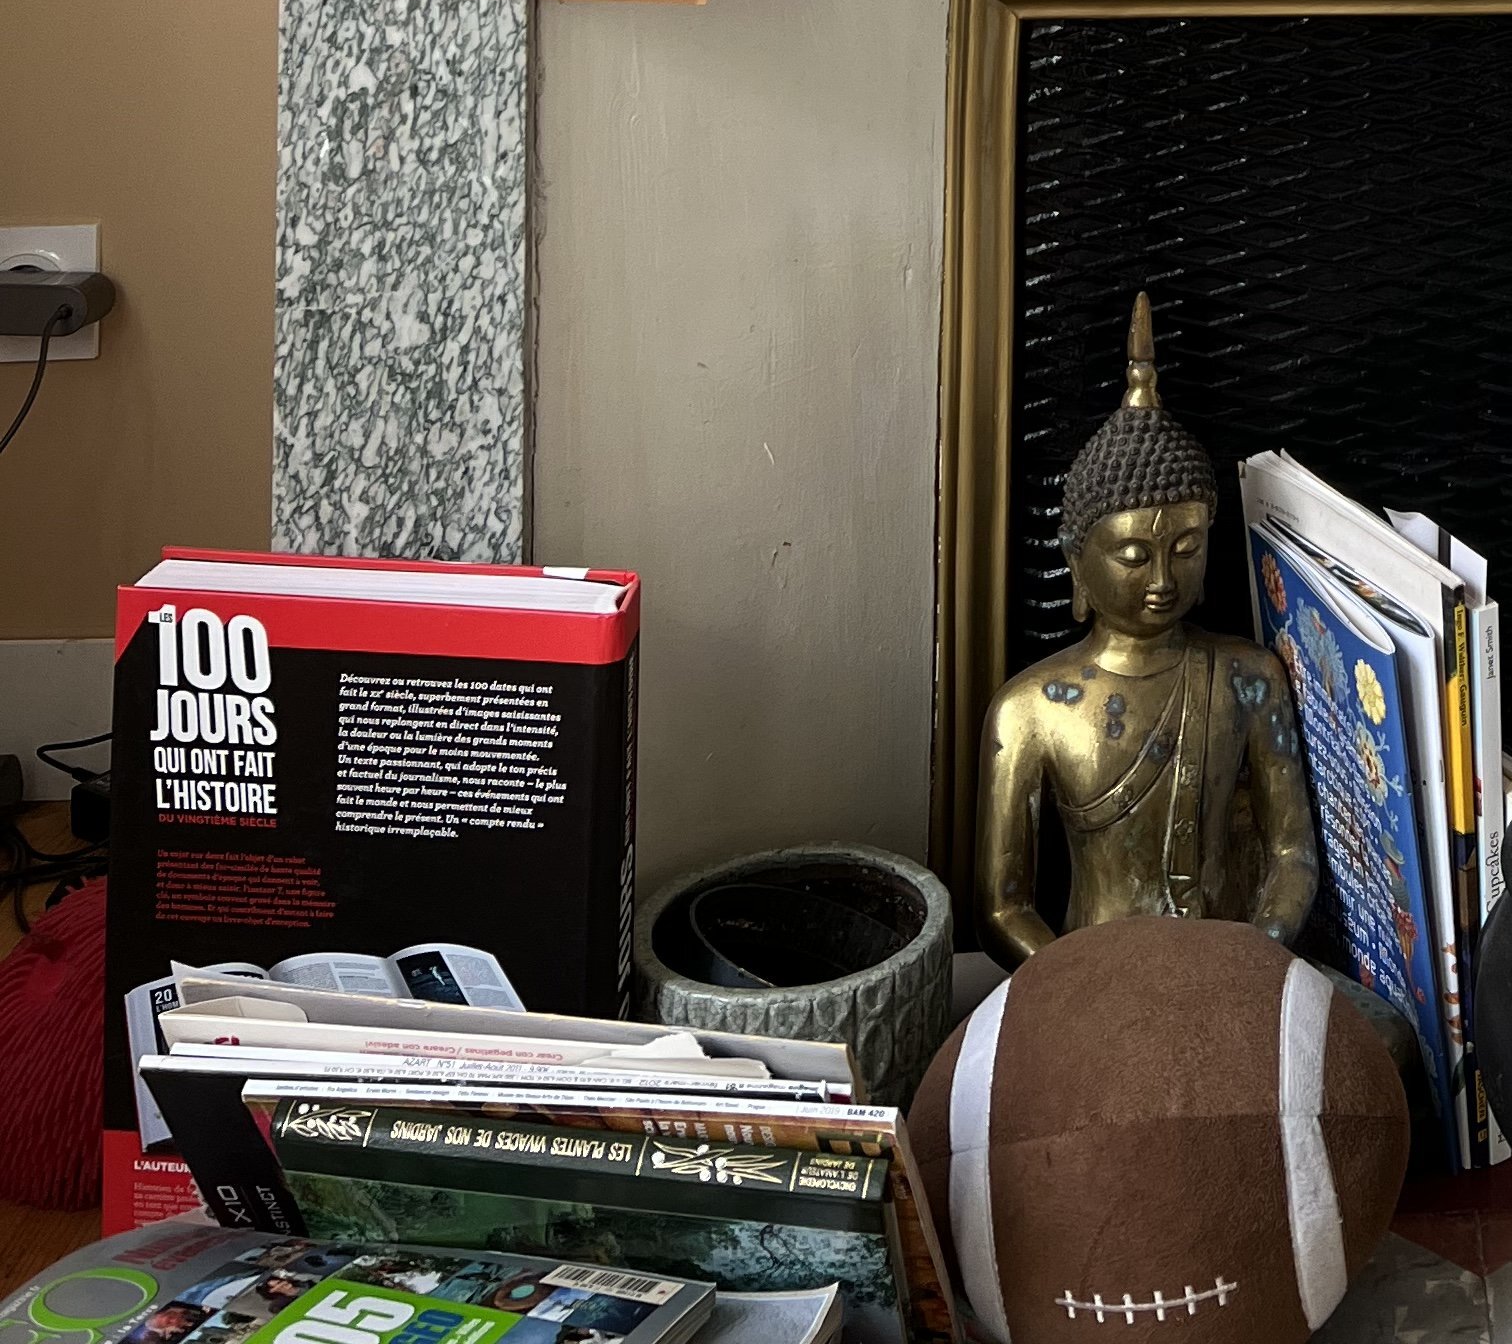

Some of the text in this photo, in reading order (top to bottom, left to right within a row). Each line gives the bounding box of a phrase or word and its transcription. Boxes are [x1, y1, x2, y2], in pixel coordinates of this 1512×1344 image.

[160, 613, 173, 623] LES
[148, 604, 271, 694] 100
[339, 673, 391, 685] Découvrez
[406, 678, 453, 688] retrouvez
[454, 678, 469, 689] les
[469, 681, 488, 690] 100
[489, 680, 517, 692] dates
[518, 684, 535, 694] qui
[536, 686, 553, 694] ont
[339, 686, 358, 697] fait
[358, 687, 368, 697] le
[385, 689, 417, 701] siècle,
[418, 691, 482, 703] superbement
[481, 695, 535, 706] présentées
[150, 689, 278, 746] JOURS
[339, 700, 369, 712] grand
[370, 701, 406, 714] format,
[338, 715, 355, 725] qui
[356, 717, 380, 725] nous
[381, 716, 434, 729] replongent
[435, 721, 448, 729] en
[449, 719, 479, 730] direct
[480, 721, 505, 732] dans
[338, 726, 553, 749] la douleur ou la lumière des grands moments
[367, 742, 402, 755] époque
[402, 746, 427, 756] pour
[428, 745, 438, 755] le
[439, 747, 469, 757] moins
[470, 750, 540, 761] mouvementée.
[154, 747, 276, 778] QUI ONT FAIT
[338, 754, 558, 777] Un texte passionnant, qui adopte le ton précis
[336, 767, 567, 791] et factuel du journalisme, nous raconte le plus
[156, 778, 277, 814] L'HISTOIRE
[374, 782, 402, 794] heure
[401, 787, 420, 796] par
[420, 785, 448, 797] heure
[457, 790, 474, 798] ces
[530, 790, 548, 804] qui
[547, 795, 564, 804] ont
[336, 794, 534, 815] fait le monde et nous permettent de mieux
[159, 813, 174, 824] DU
[176, 814, 237, 826] VINGTIÈME
[335, 810, 536, 829] comprendre le présent. Un compte rendu
[335, 821, 459, 838] historique irremplaçable.
[390, 1120, 633, 1162] LES PLANTES VIVACES DE NOS JARDINS
